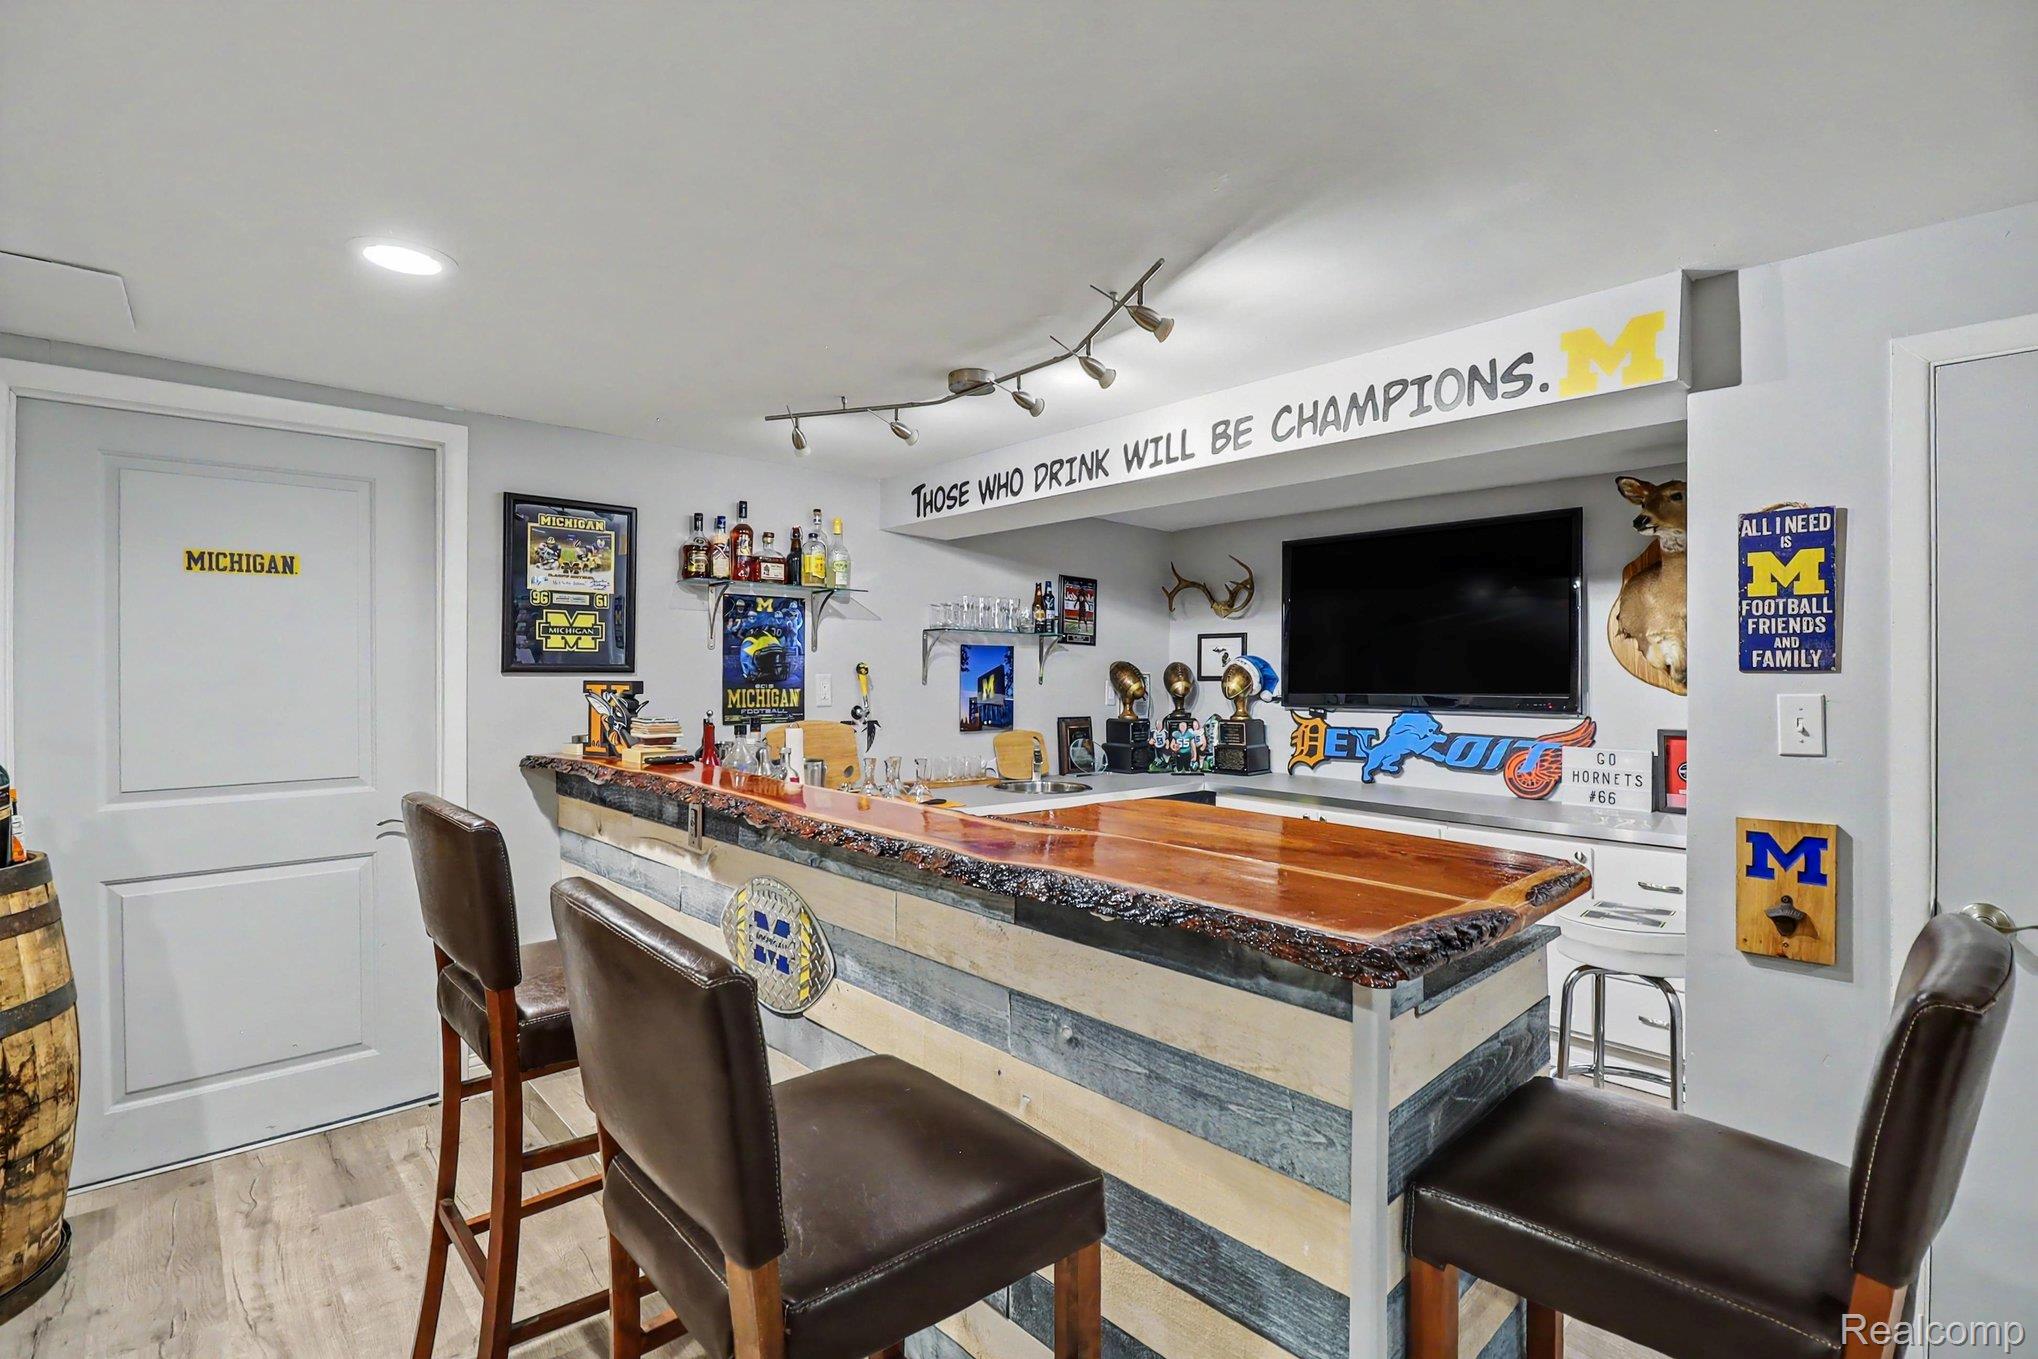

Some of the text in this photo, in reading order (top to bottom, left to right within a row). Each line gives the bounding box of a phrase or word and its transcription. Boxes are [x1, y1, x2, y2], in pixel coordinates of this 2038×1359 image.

[1559, 310, 1665, 395] M
[911, 352, 1550, 518] THOSE WHO DRINK WILL BE CHAMPIONS.
[538, 514, 606, 531] MICHIGAN
[1741, 512, 1831, 537] ALL I NEED
[1780, 535, 1792, 548] IS
[1747, 548, 1825, 597] M
[531, 591, 550, 605] 96
[595, 594, 608, 608] 61
[756, 597, 774, 612] M
[1741, 597, 1833, 616] FOOTBALL
[548, 625, 595, 635] MICHIGAN
[1747, 616, 1826, 635] FRIENDS
[1773, 636, 1800, 649] AND
[1752, 649, 1822, 668] FAMILY
[727, 688, 801, 708] MICHIGAN
[1290, 708, 1563, 778] DETOIT
[1597, 752, 1616, 766] GO
[1572, 770, 1643, 788] HORNETS
[1589, 790, 1616, 805] #66
[1746, 830, 1828, 887] M
